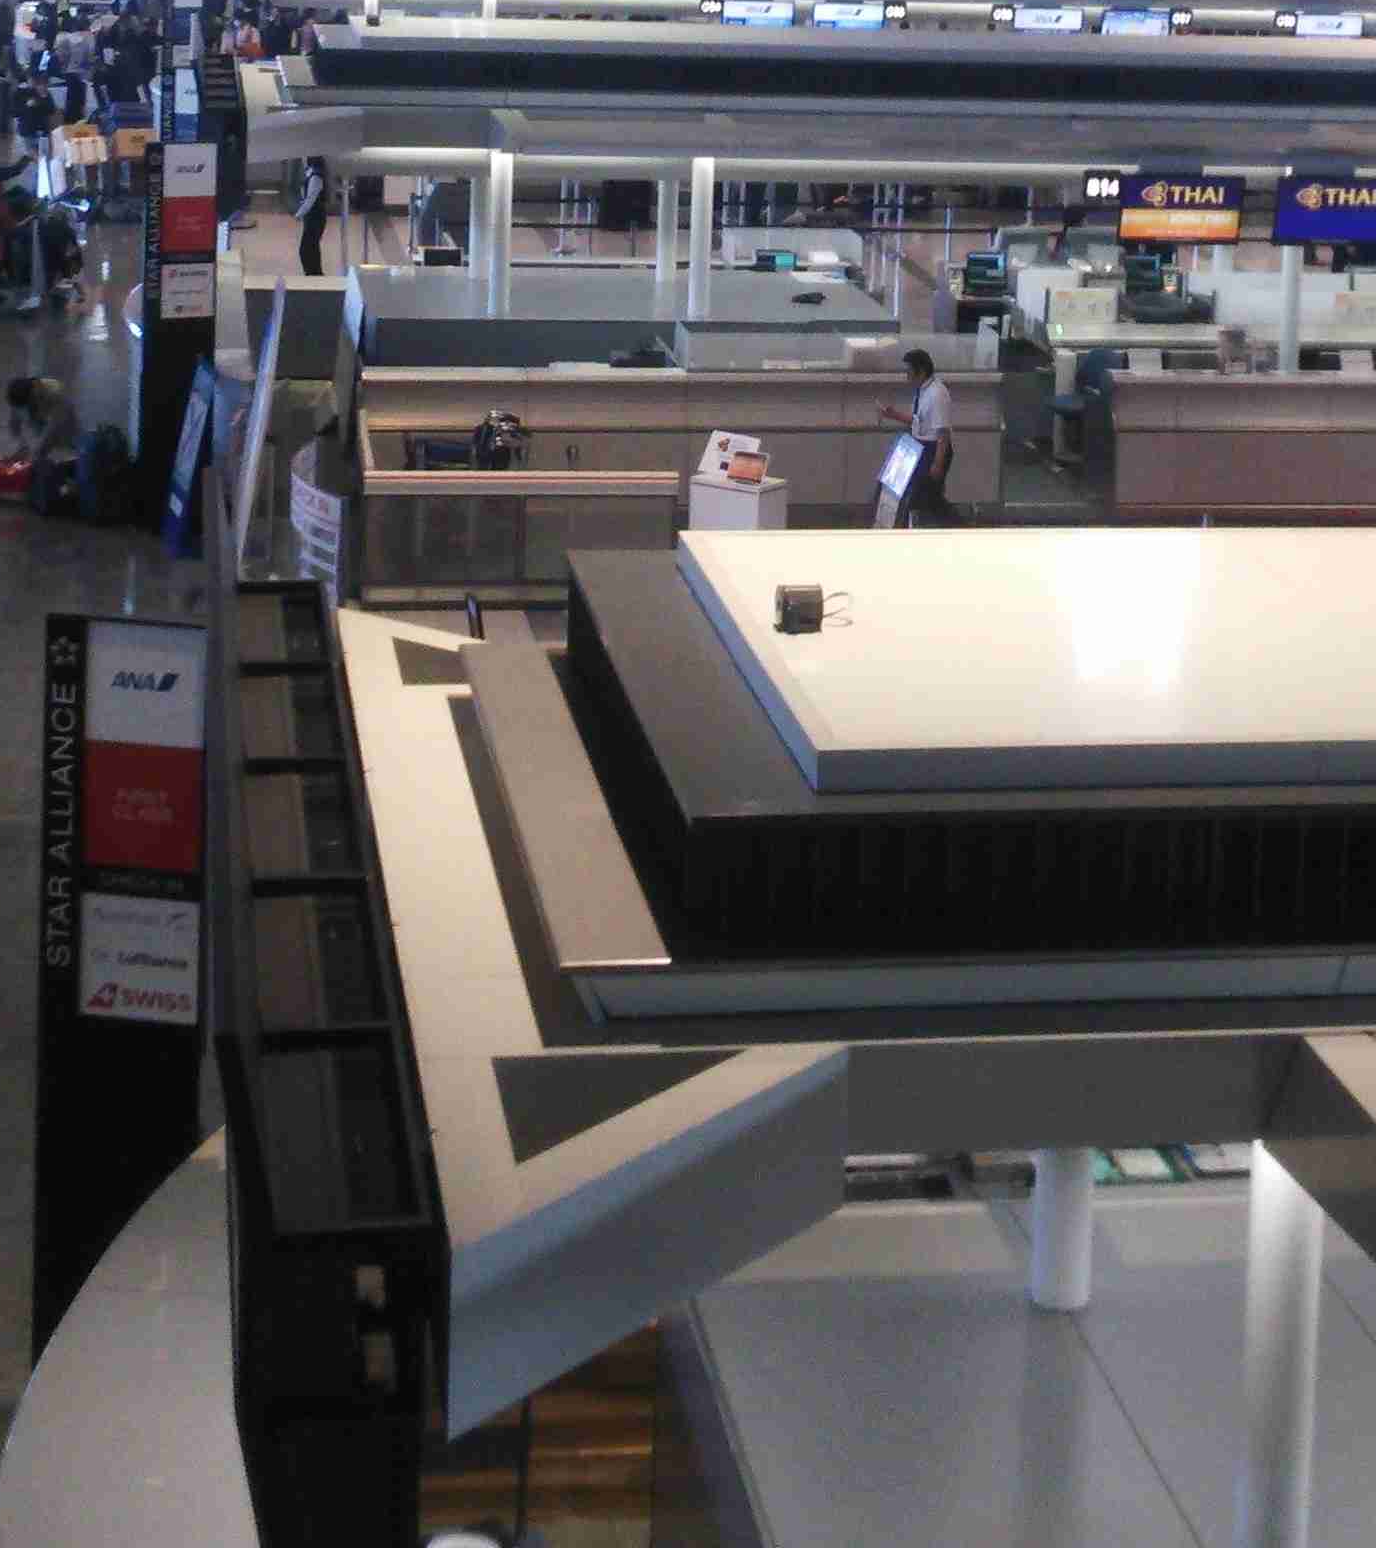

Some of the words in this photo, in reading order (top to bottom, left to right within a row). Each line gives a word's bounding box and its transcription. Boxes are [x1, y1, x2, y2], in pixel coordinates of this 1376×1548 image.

[1171, 185, 1225, 205] THAI
[111, 671, 156, 692] ANA
[50, 683, 77, 867] ALLIANCE
[46, 875, 72, 968] STAR
[121, 988, 193, 1013] SWISS
